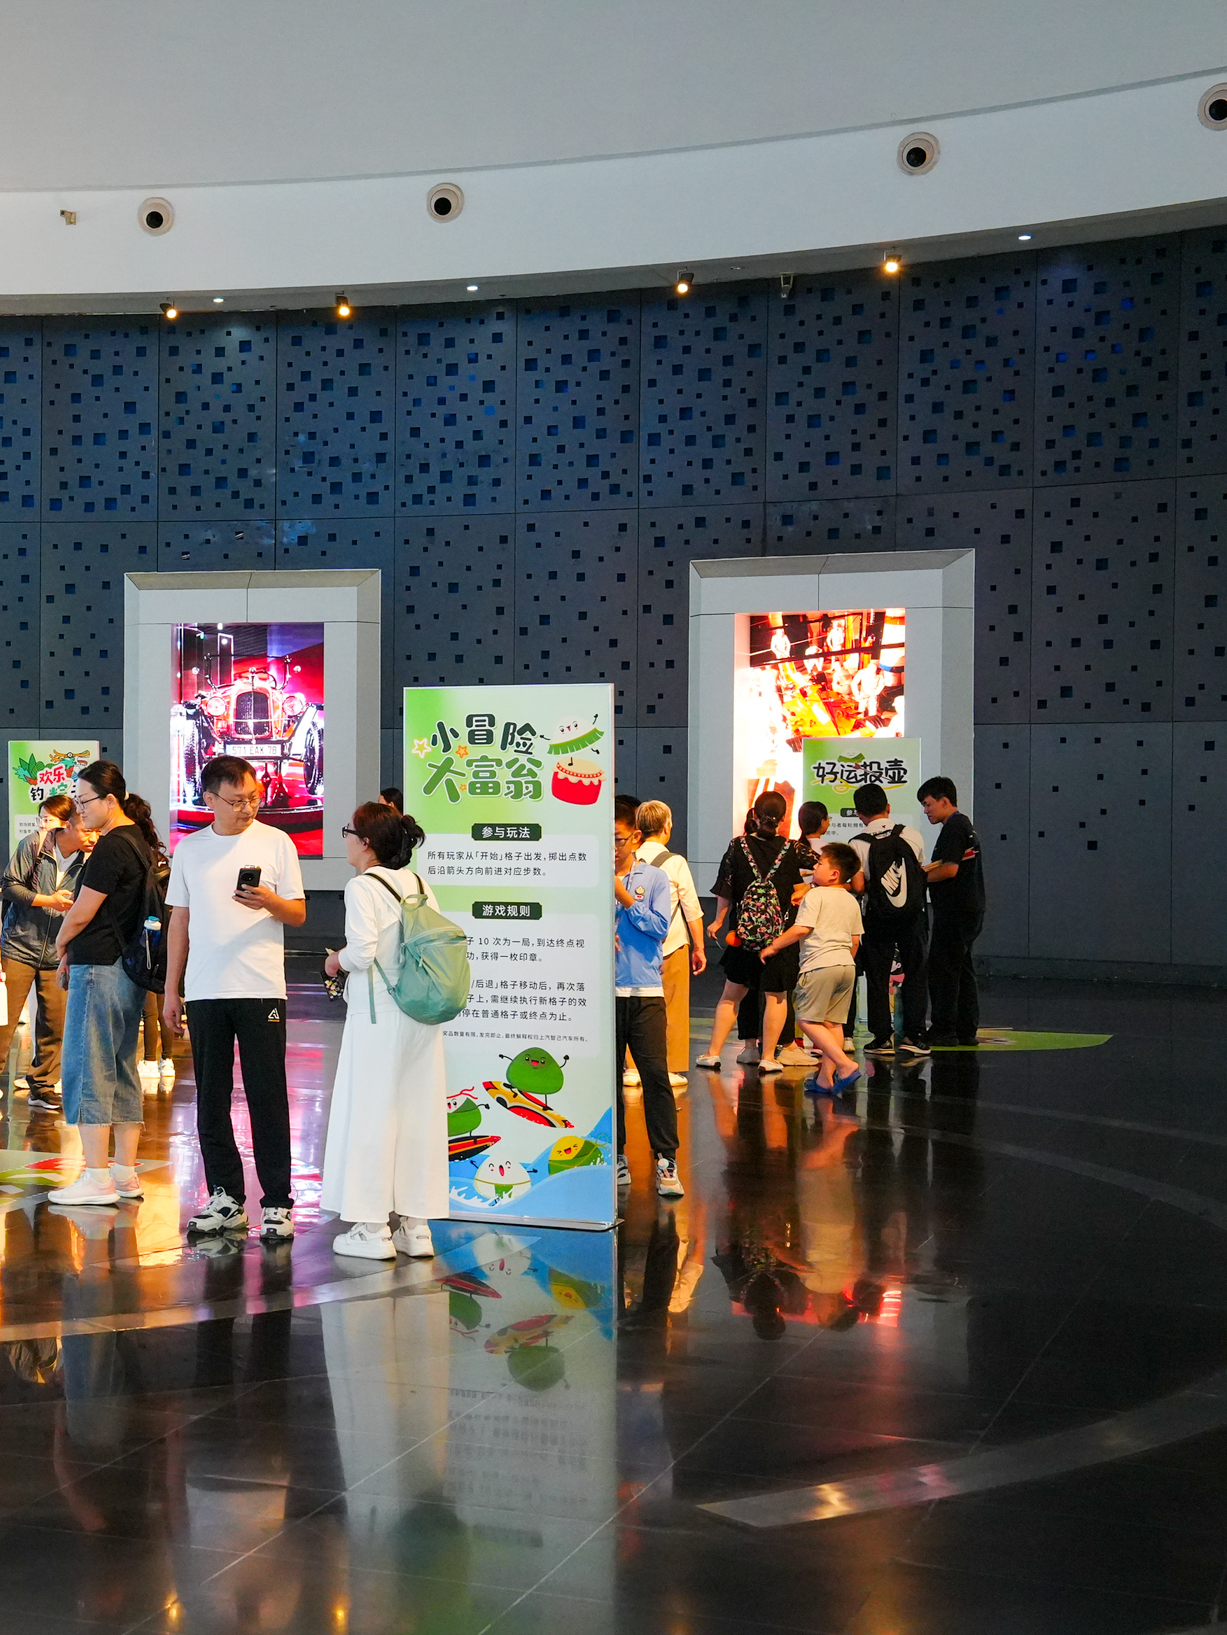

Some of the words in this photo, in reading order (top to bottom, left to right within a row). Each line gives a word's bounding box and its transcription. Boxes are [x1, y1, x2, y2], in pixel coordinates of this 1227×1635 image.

[430, 713, 537, 756] 小冒险
[38, 765, 66, 785] 欢乐
[422, 754, 543, 804] 大富翁
[812, 758, 909, 785] 好运投壶
[481, 825, 531, 839] 参与玩法
[482, 904, 531, 917] 游戏规则
[479, 937, 489, 946] 10
